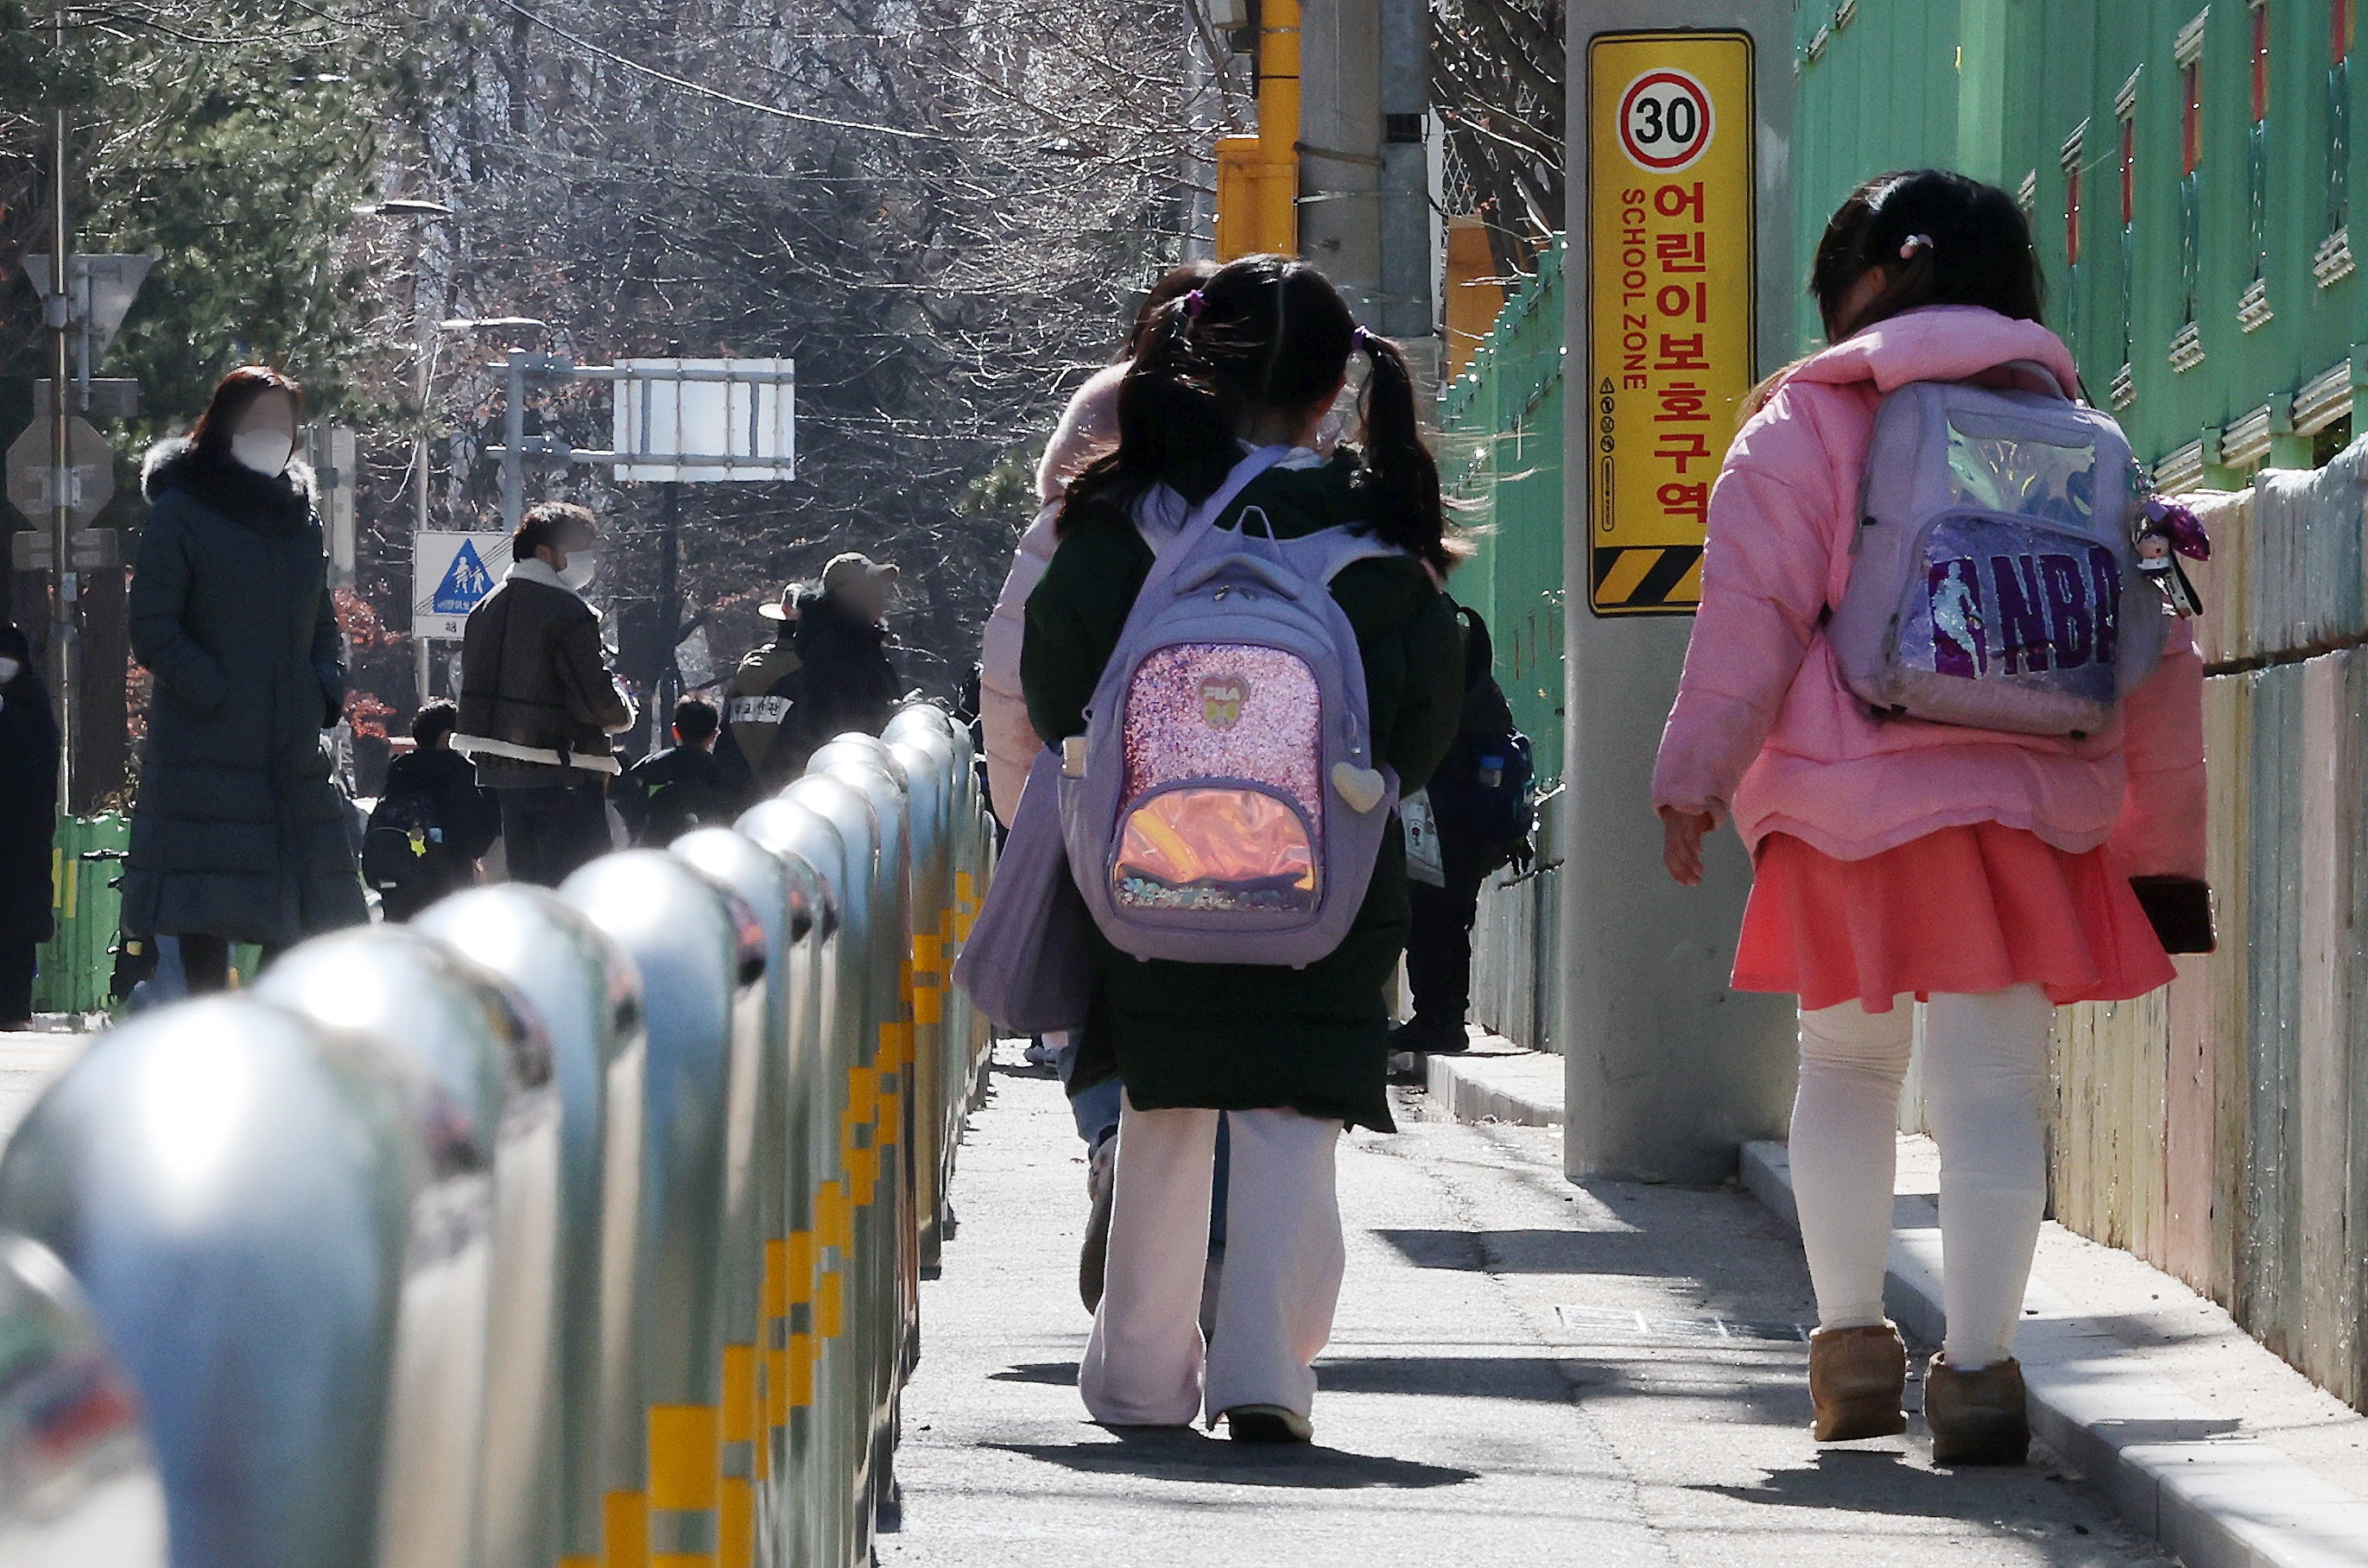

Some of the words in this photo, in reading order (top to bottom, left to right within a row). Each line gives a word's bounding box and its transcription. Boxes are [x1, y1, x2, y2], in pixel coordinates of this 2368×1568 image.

[1635, 96, 1696, 144] 30
[1621, 187, 1646, 307] SCHOOL
[1622, 313, 1648, 390] ZONE
[1653, 181, 1711, 523] 어린이보호구역
